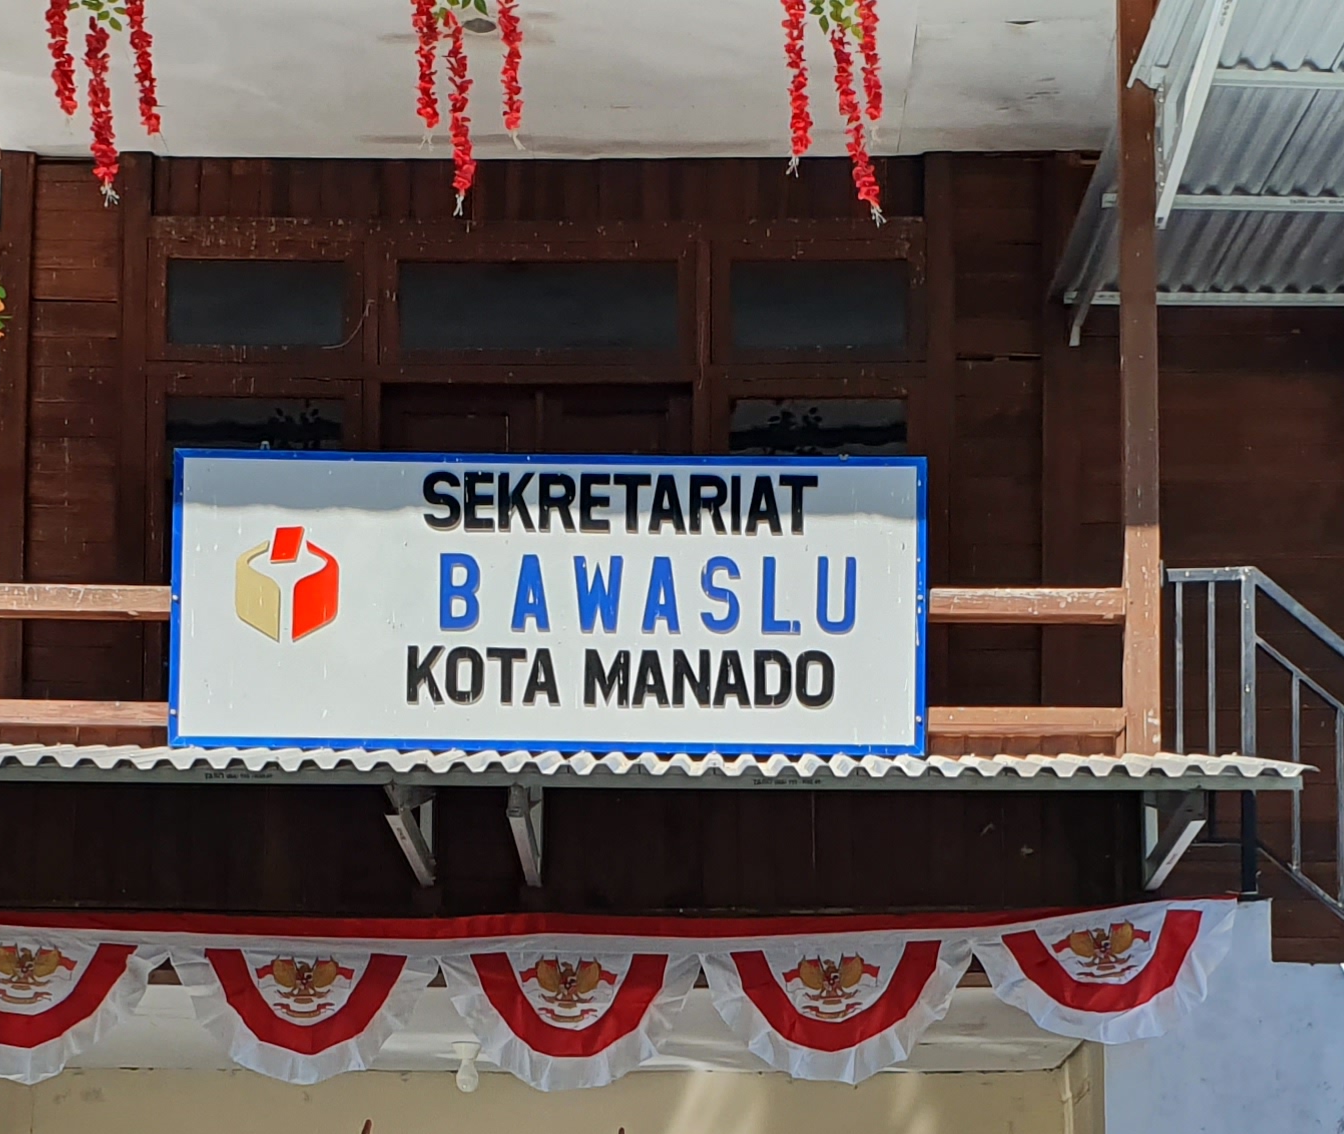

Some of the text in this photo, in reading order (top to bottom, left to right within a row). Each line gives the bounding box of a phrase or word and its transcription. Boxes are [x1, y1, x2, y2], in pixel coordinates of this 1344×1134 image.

[422, 470, 818, 535] SEKRETARIAT
[439, 553, 857, 635] BAWASLU
[406, 645, 835, 710] KOTA MANADO
